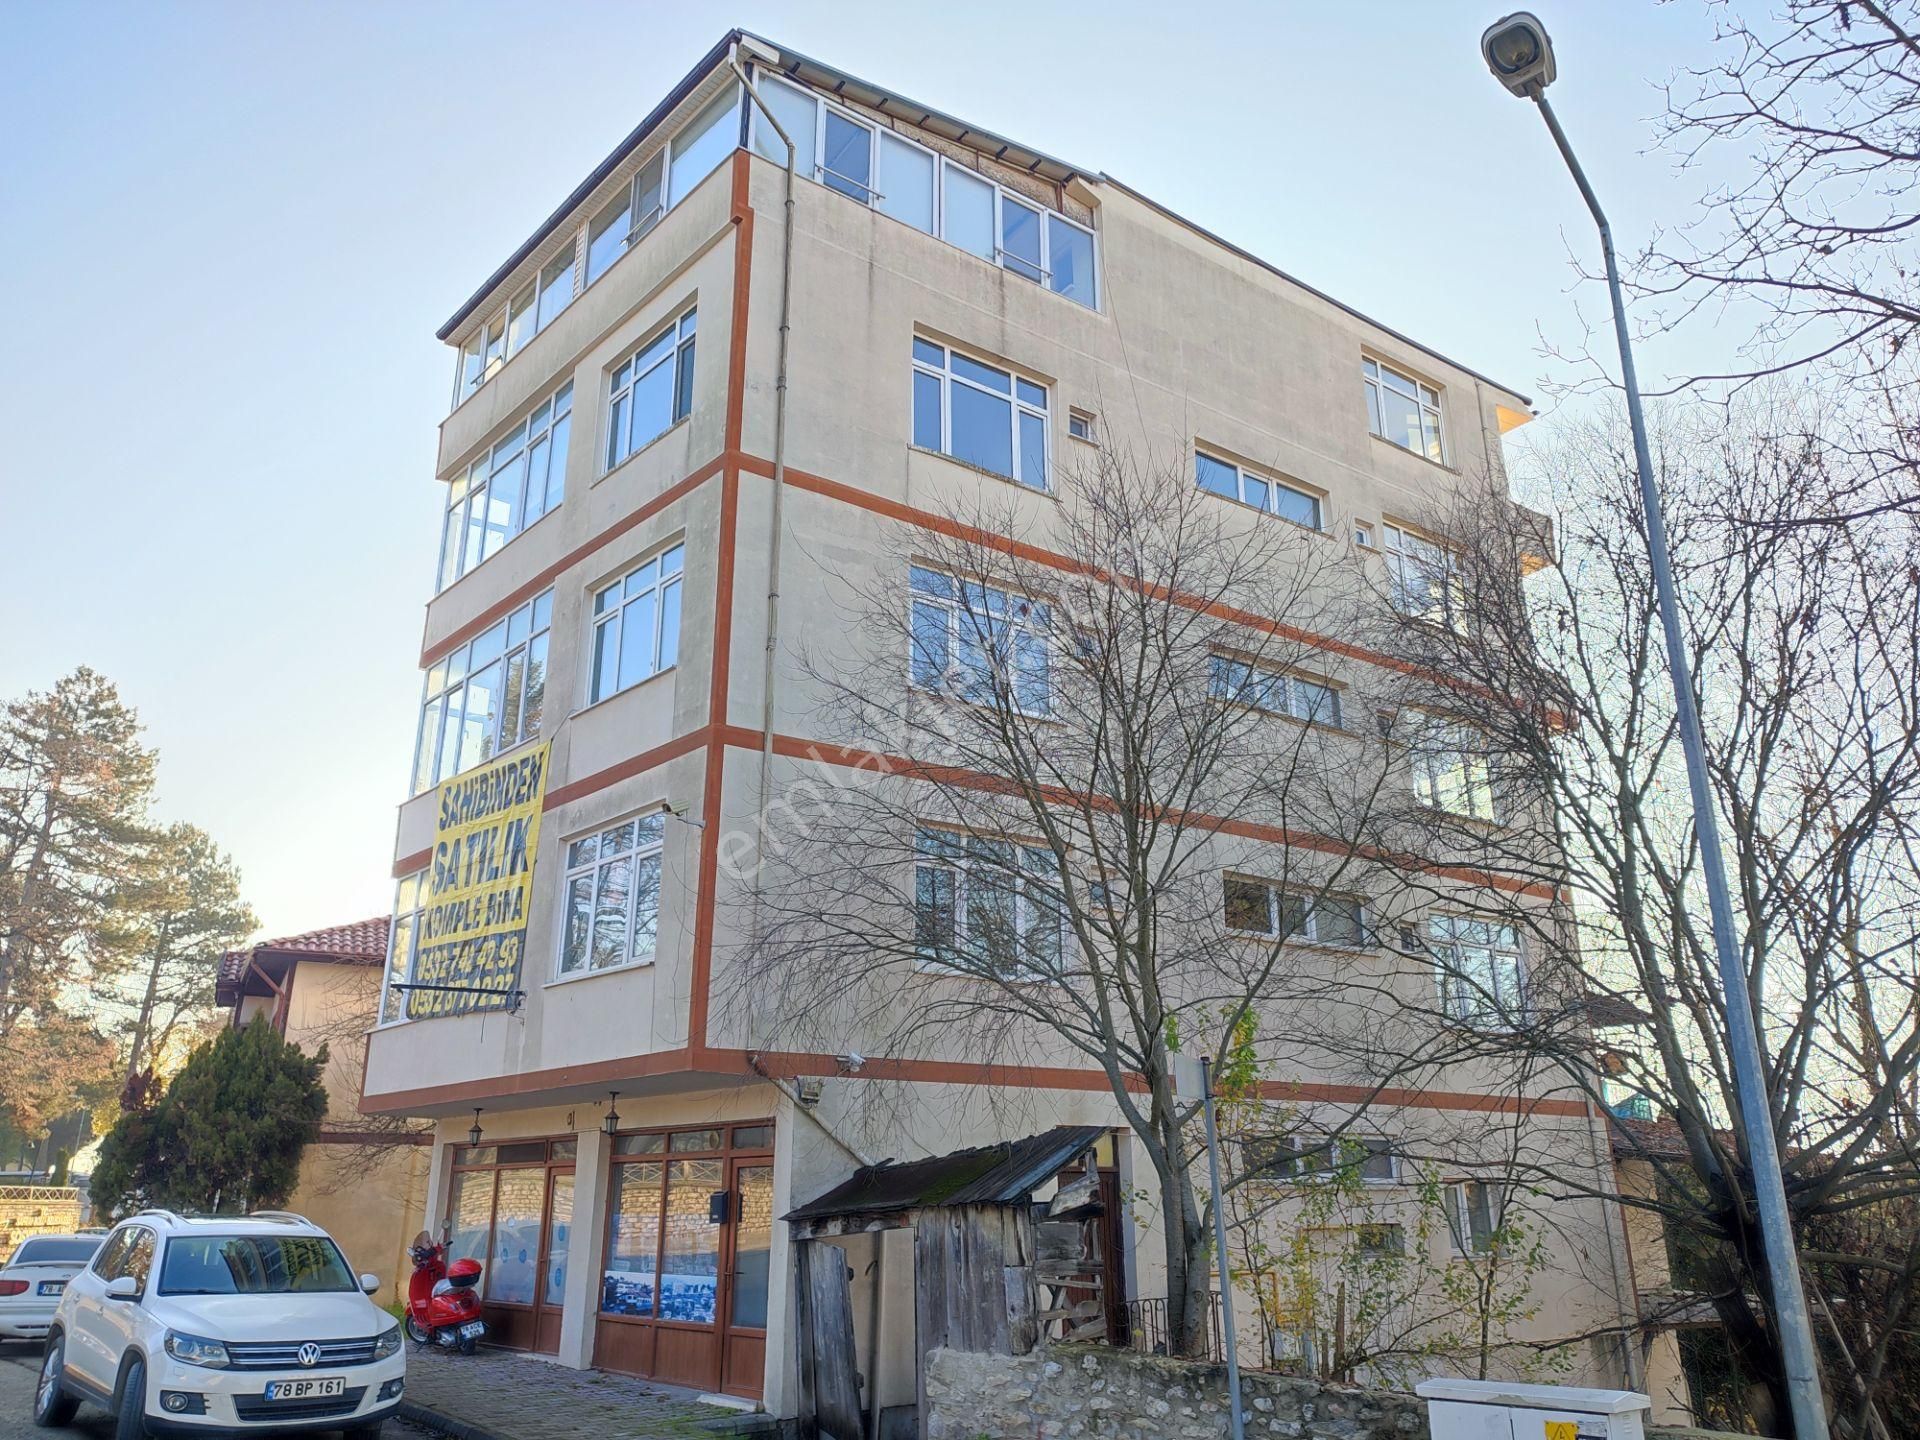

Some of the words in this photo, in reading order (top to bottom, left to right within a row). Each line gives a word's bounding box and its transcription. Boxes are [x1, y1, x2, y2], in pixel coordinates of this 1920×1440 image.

[432, 814, 533, 896] SATILIK
[423, 895, 482, 940] KOMPLE
[417, 950, 448, 981] 0532
[476, 940, 496, 973] 42
[498, 936, 518, 969] 93
[274, 1384, 292, 1397] 78
[295, 1382, 313, 1396] BP
[319, 1380, 341, 1394] 161
